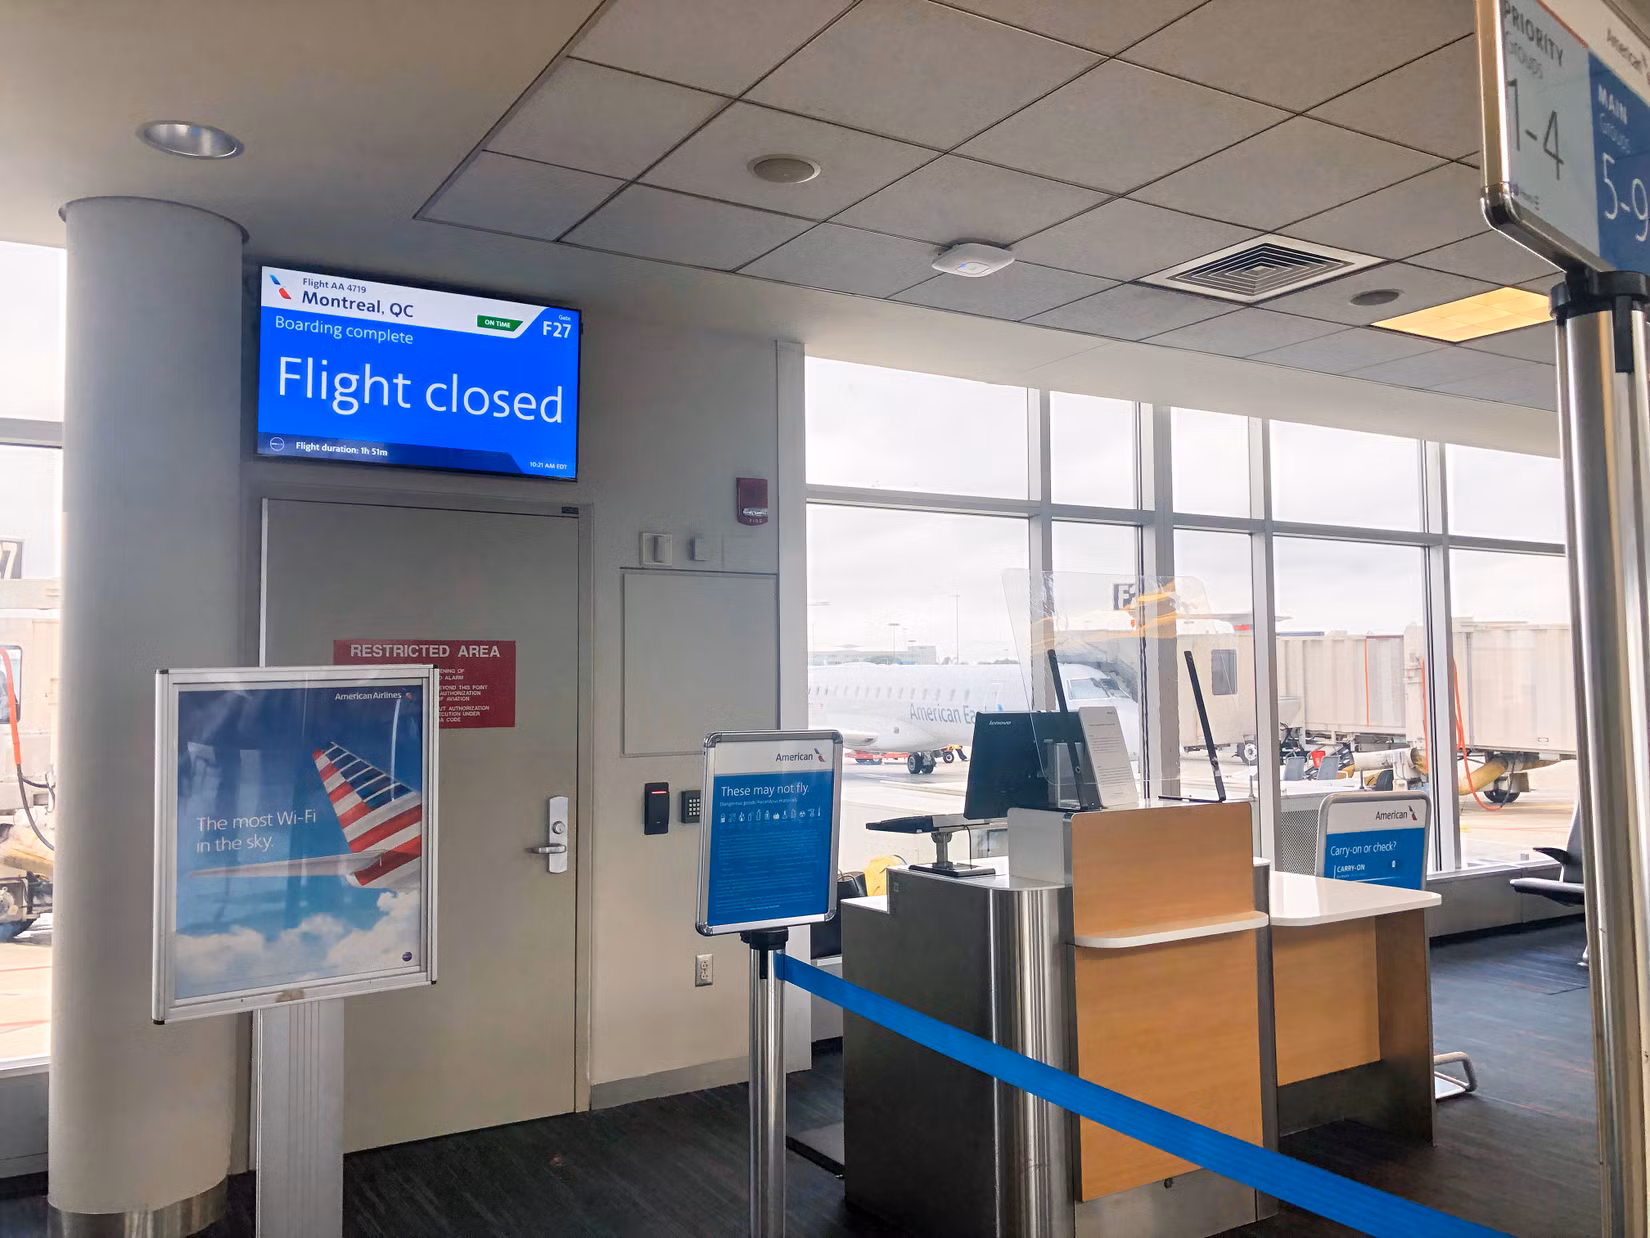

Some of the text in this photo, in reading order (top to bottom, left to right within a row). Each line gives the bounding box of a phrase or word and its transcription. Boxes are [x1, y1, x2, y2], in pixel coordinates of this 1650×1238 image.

[1503, 0, 1564, 68] PRIORITY
[1598, 83, 1628, 125] MAIN
[1507, 78, 1565, 181] 1-4
[1602, 152, 1649, 242] 5-9
[302, 277, 367, 294] Flight AA 4719
[302, 290, 414, 318] Montreal, QC
[275, 315, 414, 345] Boarding complete
[496, 320, 511, 329] TIME
[543, 320, 572, 339] F27
[279, 356, 563, 424] Flight closed
[295, 441, 388, 456] Flight duration: 1h 51m
[350, 644, 501, 658] RESTRICTED AREA
[335, 690, 402, 701] American Airlines
[909, 703, 961, 724] American
[775, 752, 814, 762] American
[721, 782, 810, 798] These may not fly.
[197, 809, 316, 832] The most Wi-Fi
[1375, 810, 1408, 820] American
[196, 833, 274, 853] in the sky.
[1330, 841, 1397, 858] Carry-on or check?
[1337, 864, 1365, 872] CARRY-ON
